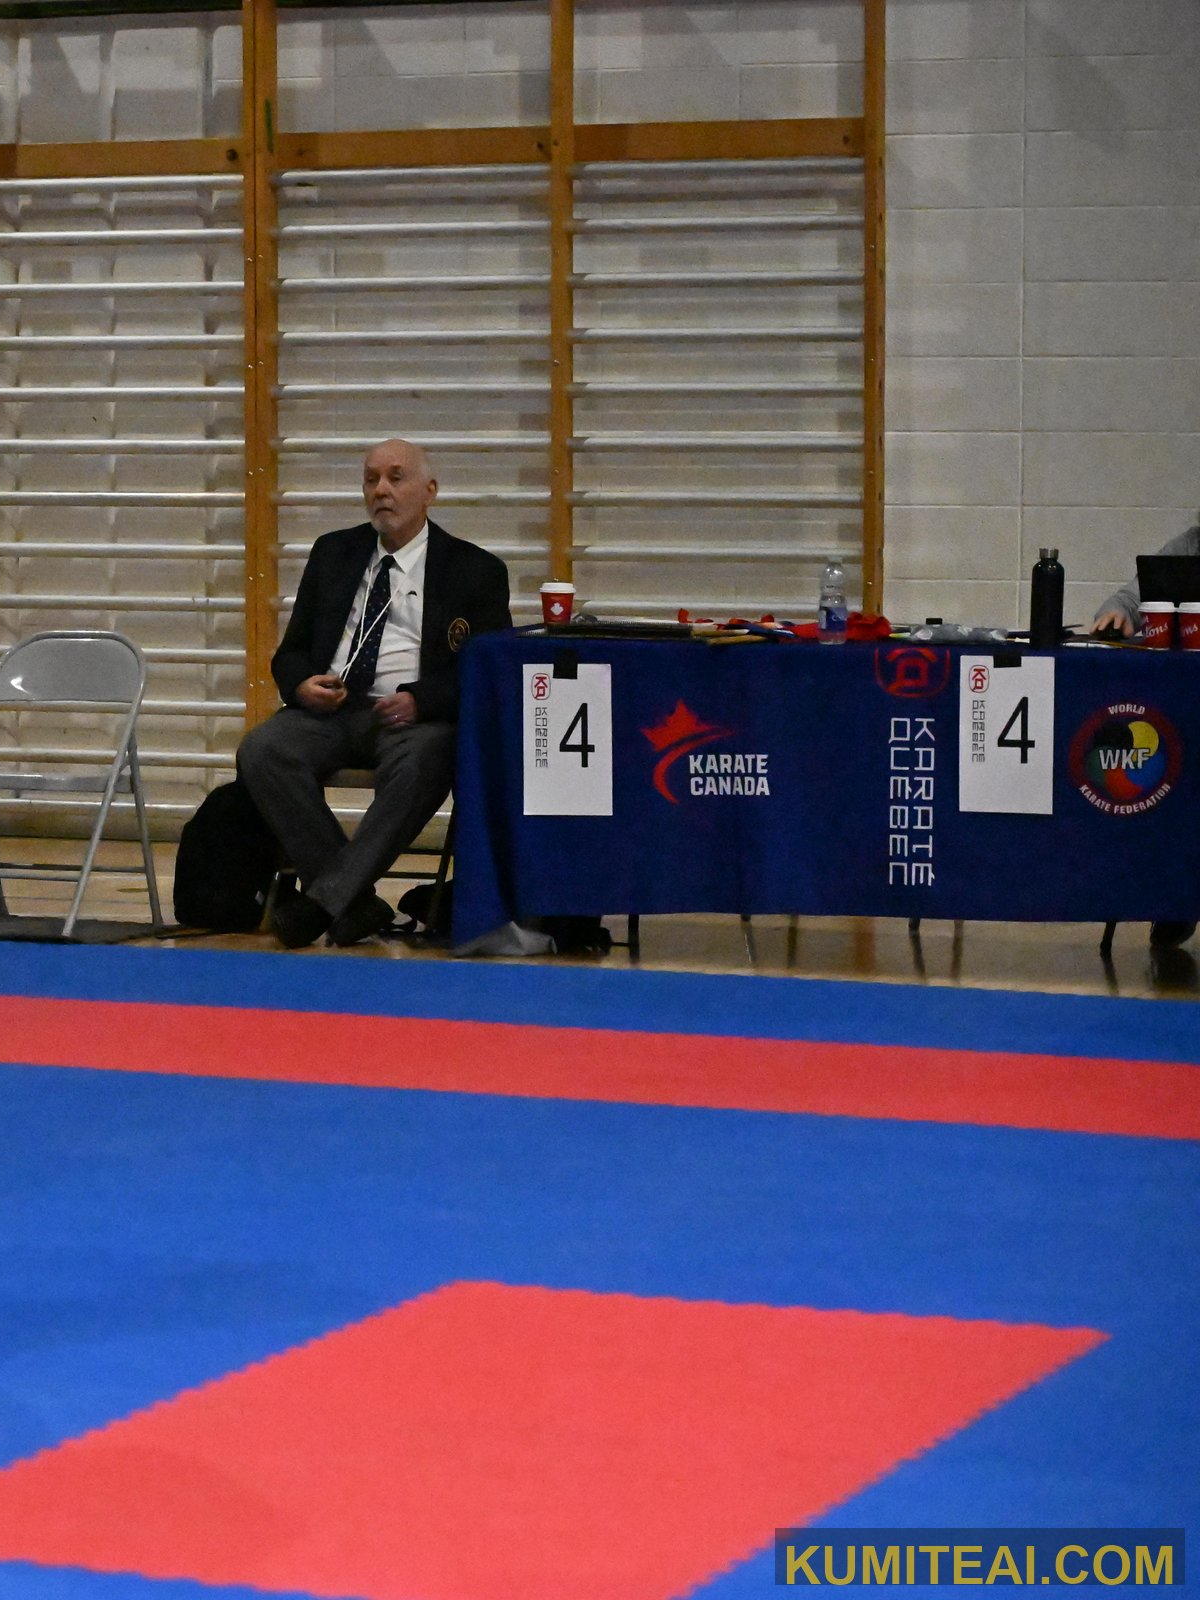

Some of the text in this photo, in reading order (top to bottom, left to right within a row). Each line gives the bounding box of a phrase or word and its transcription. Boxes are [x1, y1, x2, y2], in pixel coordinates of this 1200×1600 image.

[1108, 704, 1146, 715] WORLD
[559, 702, 595, 768] 4
[997, 696, 1036, 764] 4
[689, 754, 769, 774] KARATE
[1099, 748, 1150, 770] WKF
[690, 776, 770, 796] CANADA
[1079, 783, 1171, 814] KARATE FEDERATION
